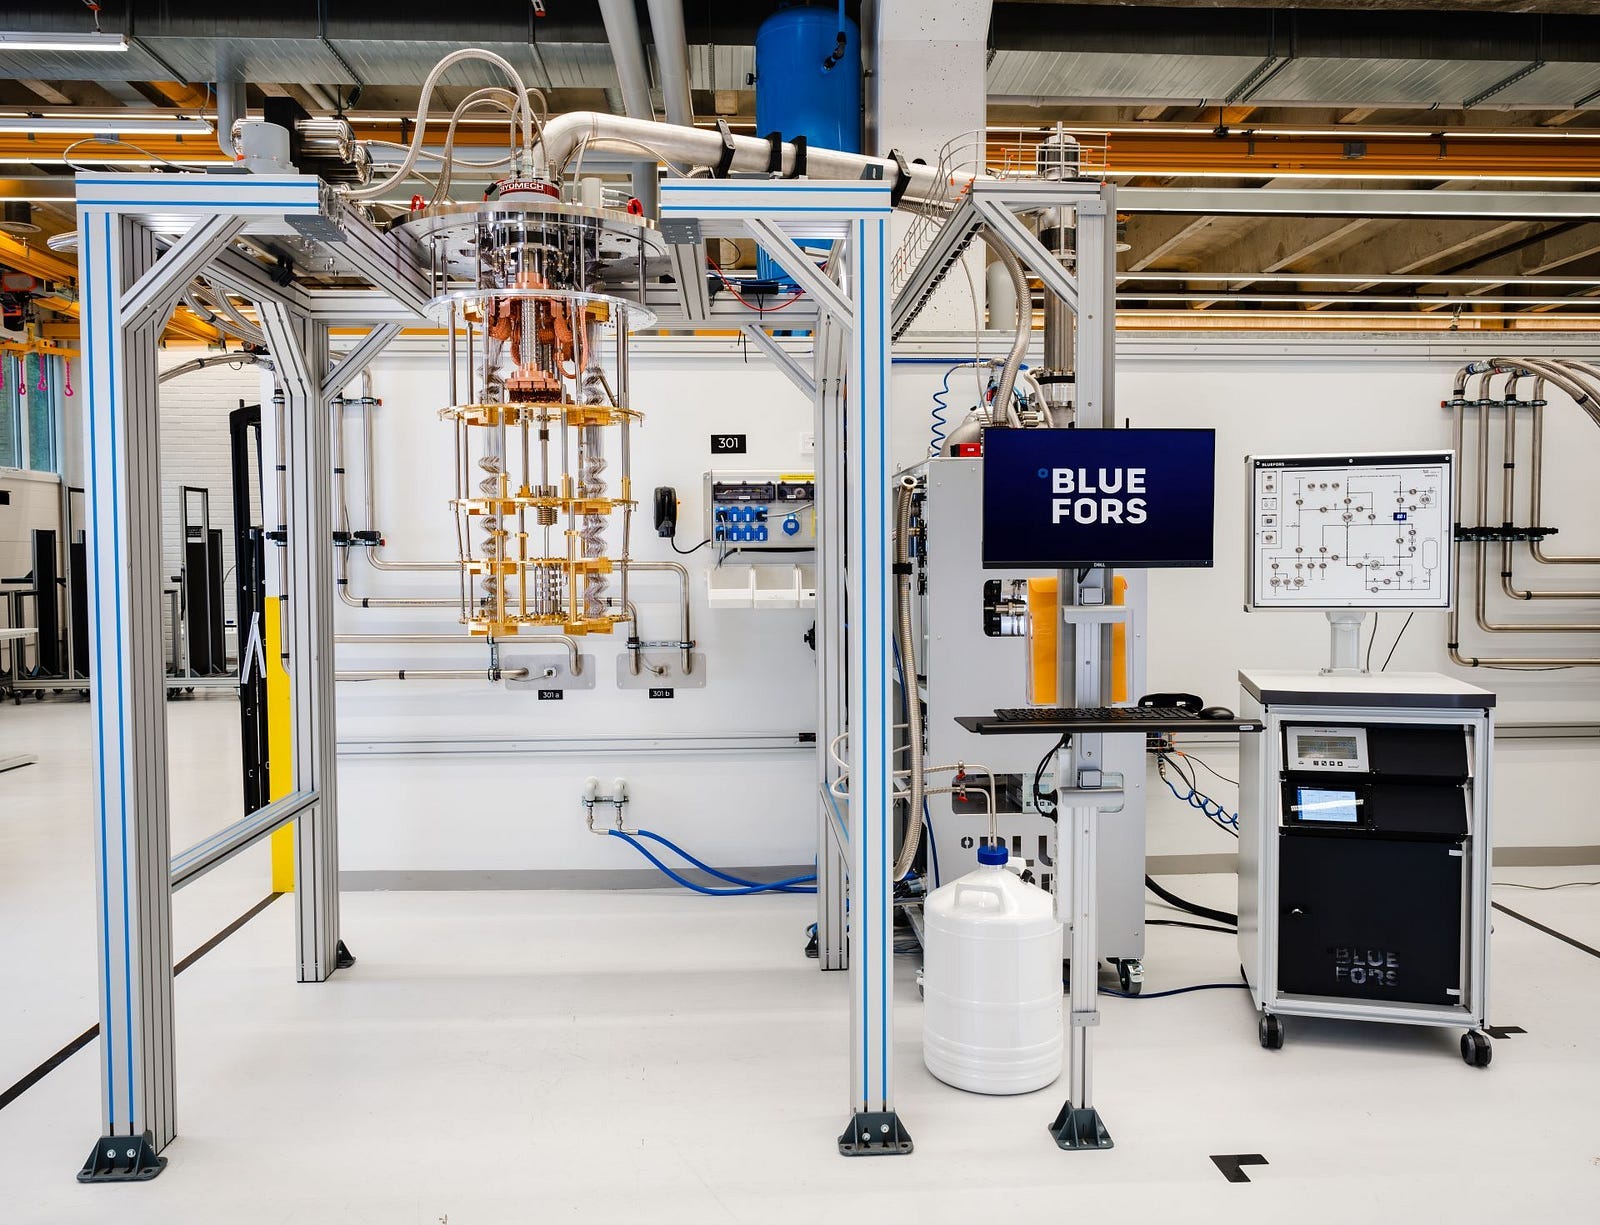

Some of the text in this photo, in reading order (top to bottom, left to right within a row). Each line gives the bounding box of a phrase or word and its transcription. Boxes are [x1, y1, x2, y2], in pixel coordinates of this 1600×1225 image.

[718, 437, 738, 449] 301
[1052, 468, 1146, 494] BLUE
[1052, 498, 1147, 525] FORS
[542, 691, 554, 699] 301
[1336, 948, 1399, 968] BLUE
[1336, 967, 1398, 986] FORS
